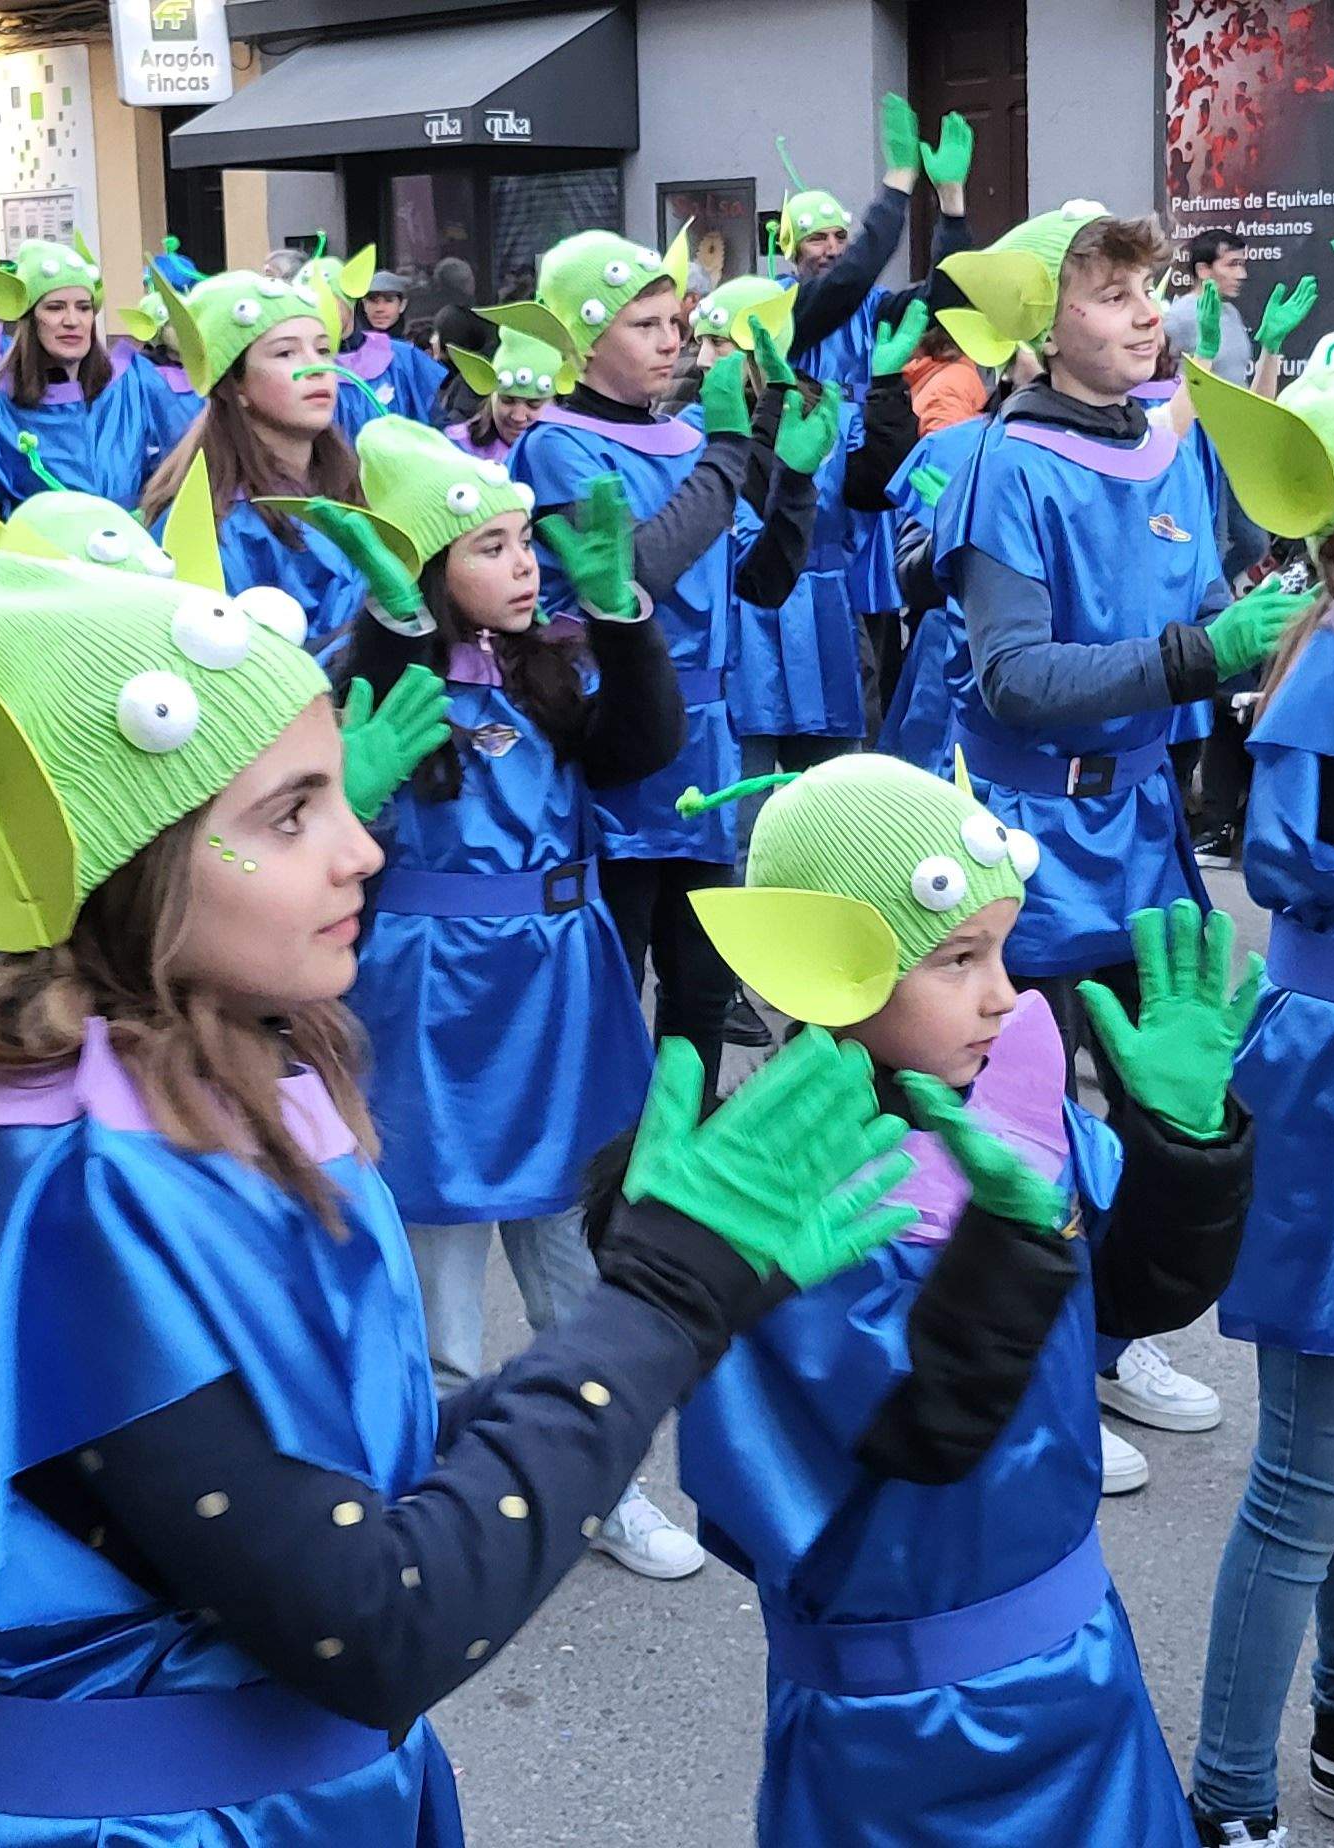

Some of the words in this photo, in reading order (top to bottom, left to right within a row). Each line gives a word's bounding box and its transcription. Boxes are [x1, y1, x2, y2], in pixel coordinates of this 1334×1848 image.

[140, 46, 214, 71] Aragón
[147, 73, 210, 92] Fincas
[1171, 195, 1241, 212] Perfumes
[1243, 193, 1263, 209] de
[1236, 220, 1313, 237] Artesanos
